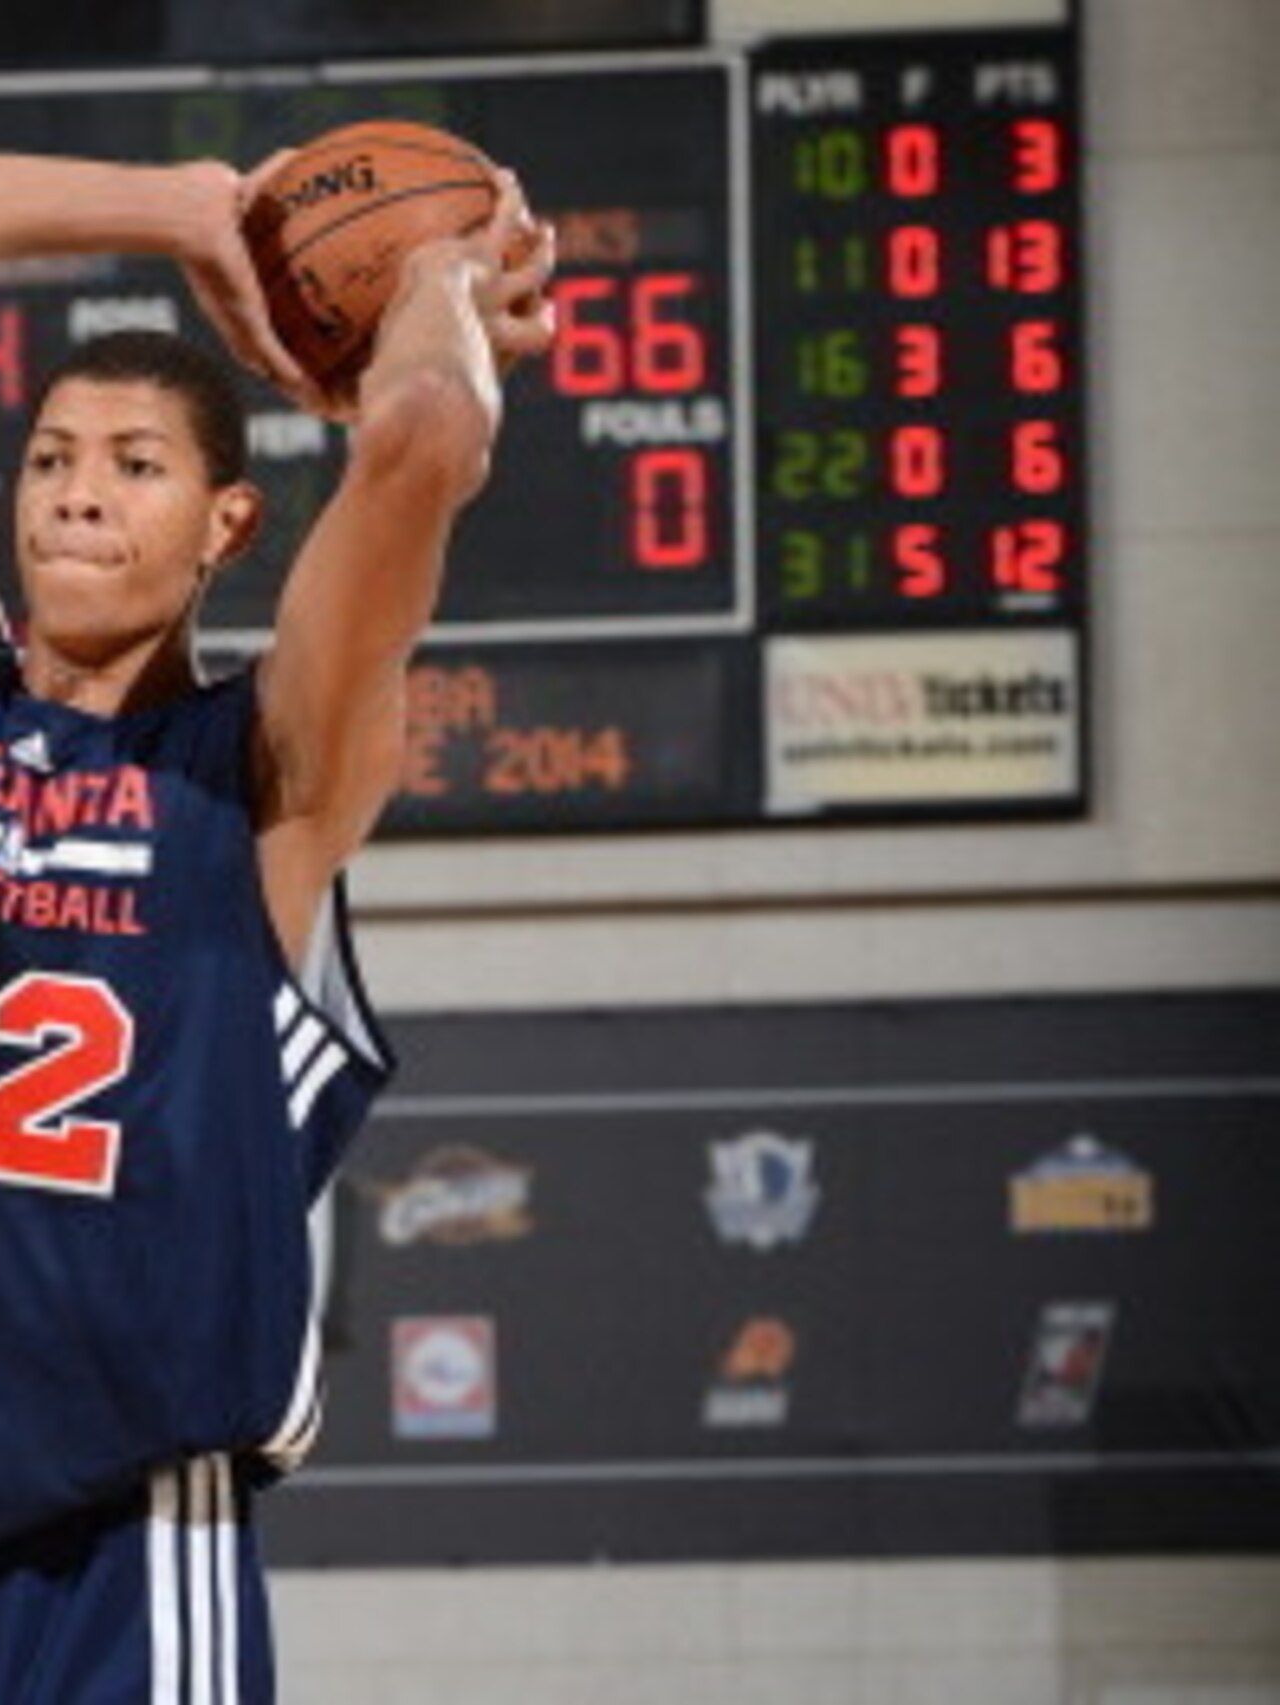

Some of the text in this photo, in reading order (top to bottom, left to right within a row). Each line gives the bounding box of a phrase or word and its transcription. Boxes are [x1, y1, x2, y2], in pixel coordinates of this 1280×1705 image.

[889, 124, 939, 196] 0
[1012, 119, 1060, 193] 3
[890, 224, 939, 297] 0
[986, 219, 1060, 293] 13
[550, 276, 705, 394] 66
[895, 324, 941, 398] 3
[1011, 321, 1060, 393] 6
[581, 400, 725, 446] FOULS
[1012, 420, 1063, 494] 6
[892, 426, 943, 497] 0
[633, 449, 707, 567] 0
[893, 523, 945, 597] 5
[994, 520, 1063, 592] 12
[482, 726, 630, 794] 2014
